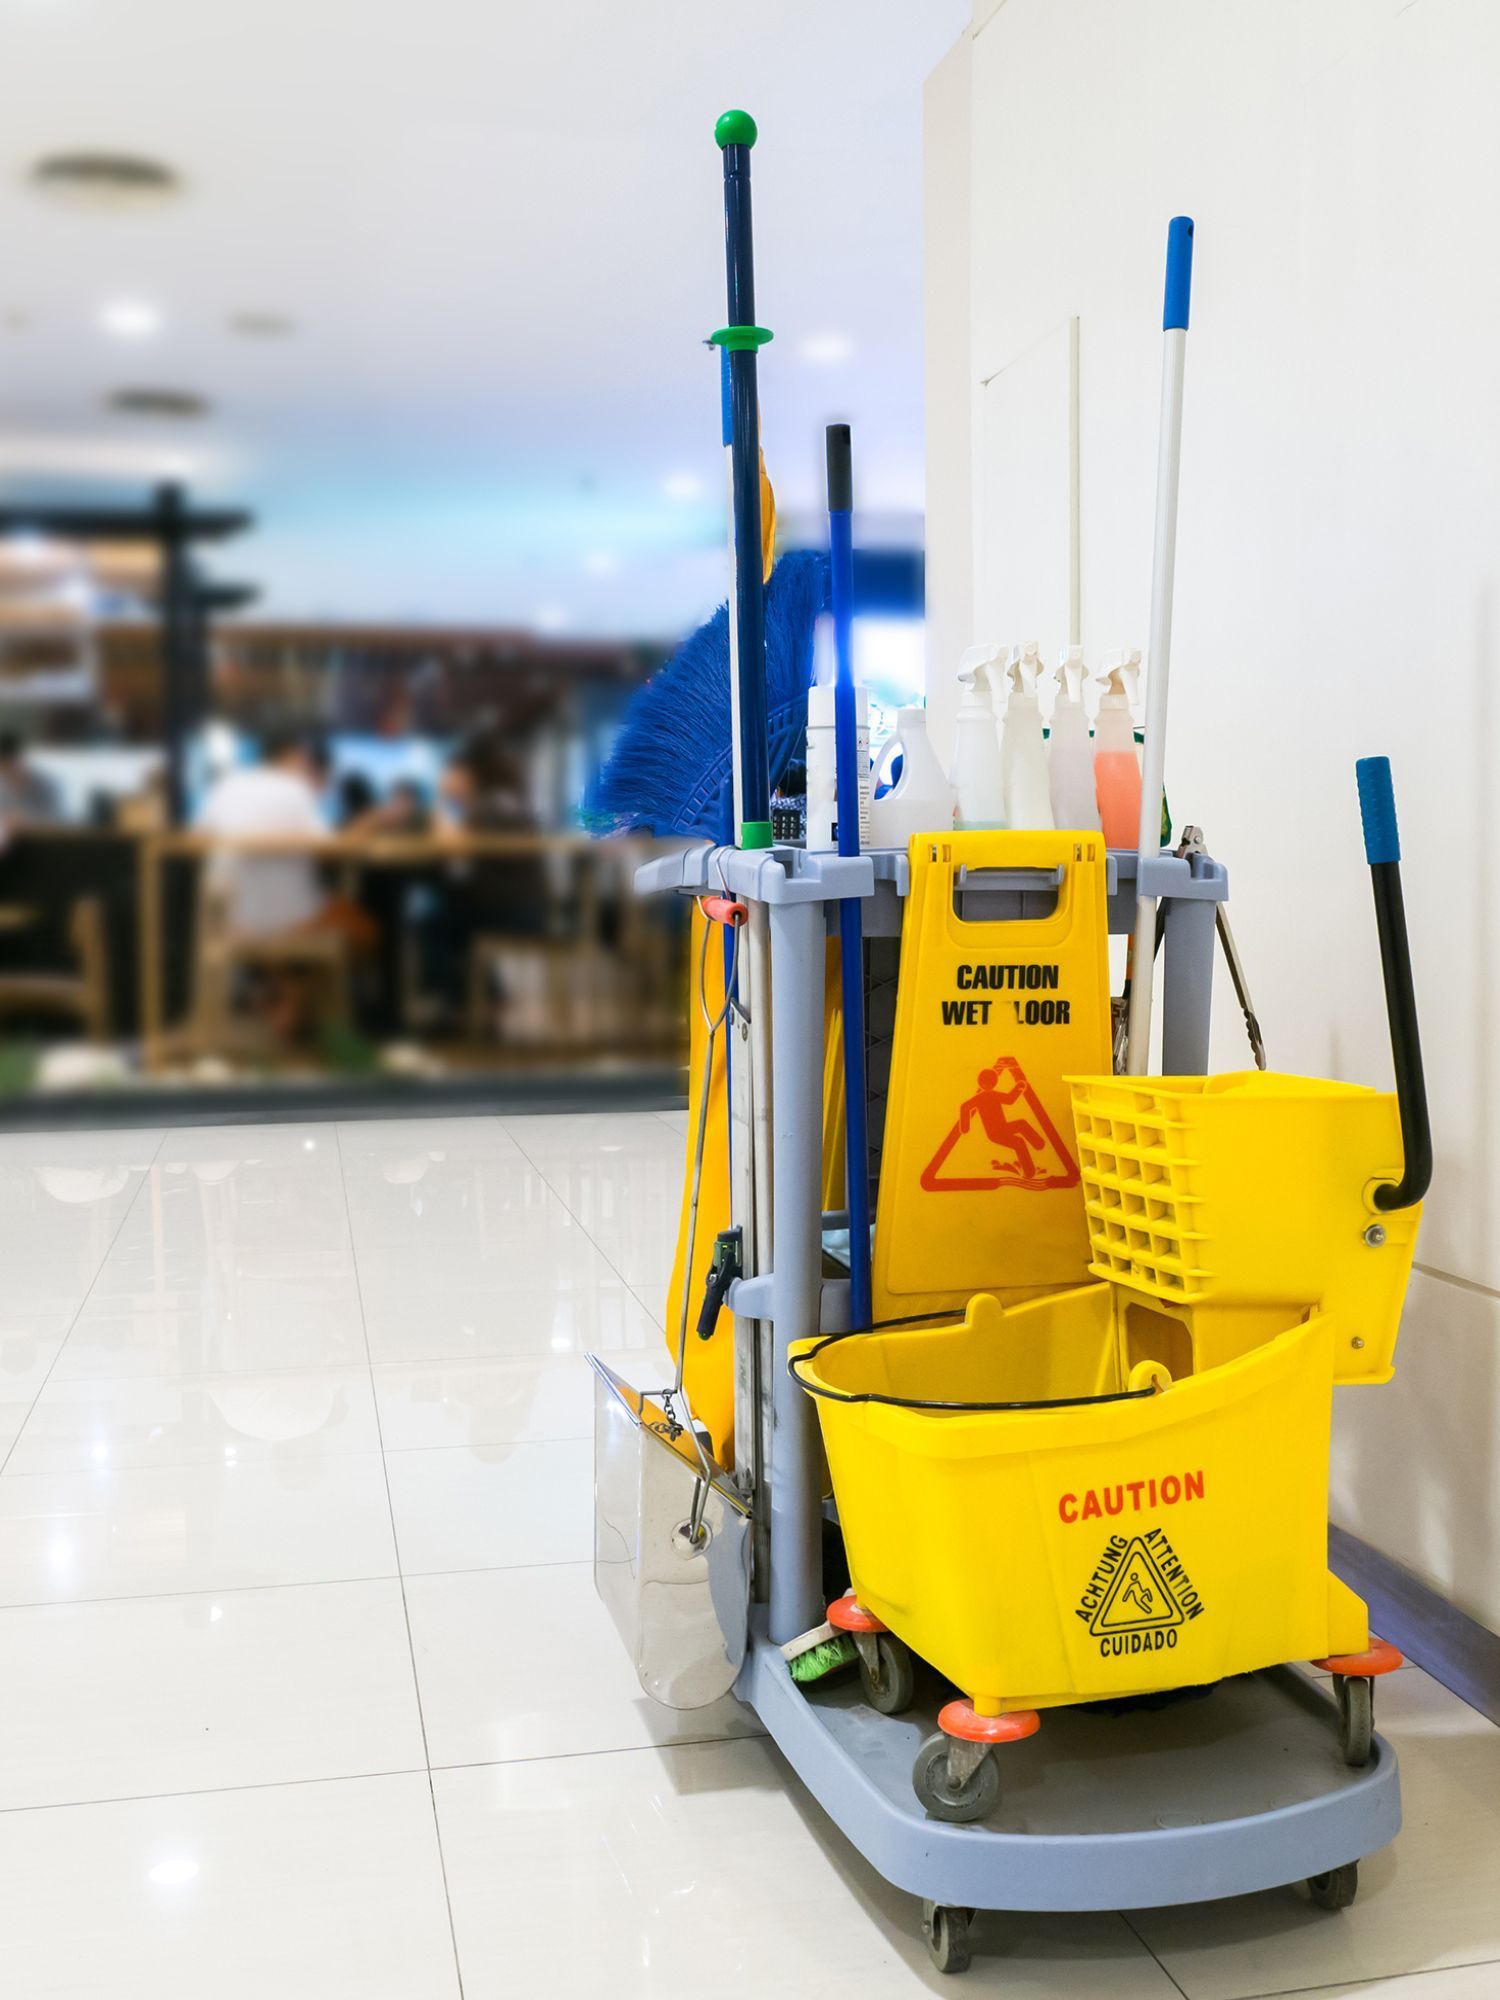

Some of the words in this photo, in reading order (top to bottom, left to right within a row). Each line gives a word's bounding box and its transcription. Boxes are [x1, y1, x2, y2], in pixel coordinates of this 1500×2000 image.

[957, 964, 1059, 990] CAUTION
[942, 1000, 992, 1026] WET
[1004, 1000, 1071, 1026] LOOR
[1059, 1470, 1205, 1524] CAUTION
[1075, 1534, 1128, 1623] ACHTUNG
[1144, 1527, 1205, 1620] ATTENTION
[1100, 1628, 1178, 1658] CUIDADO
